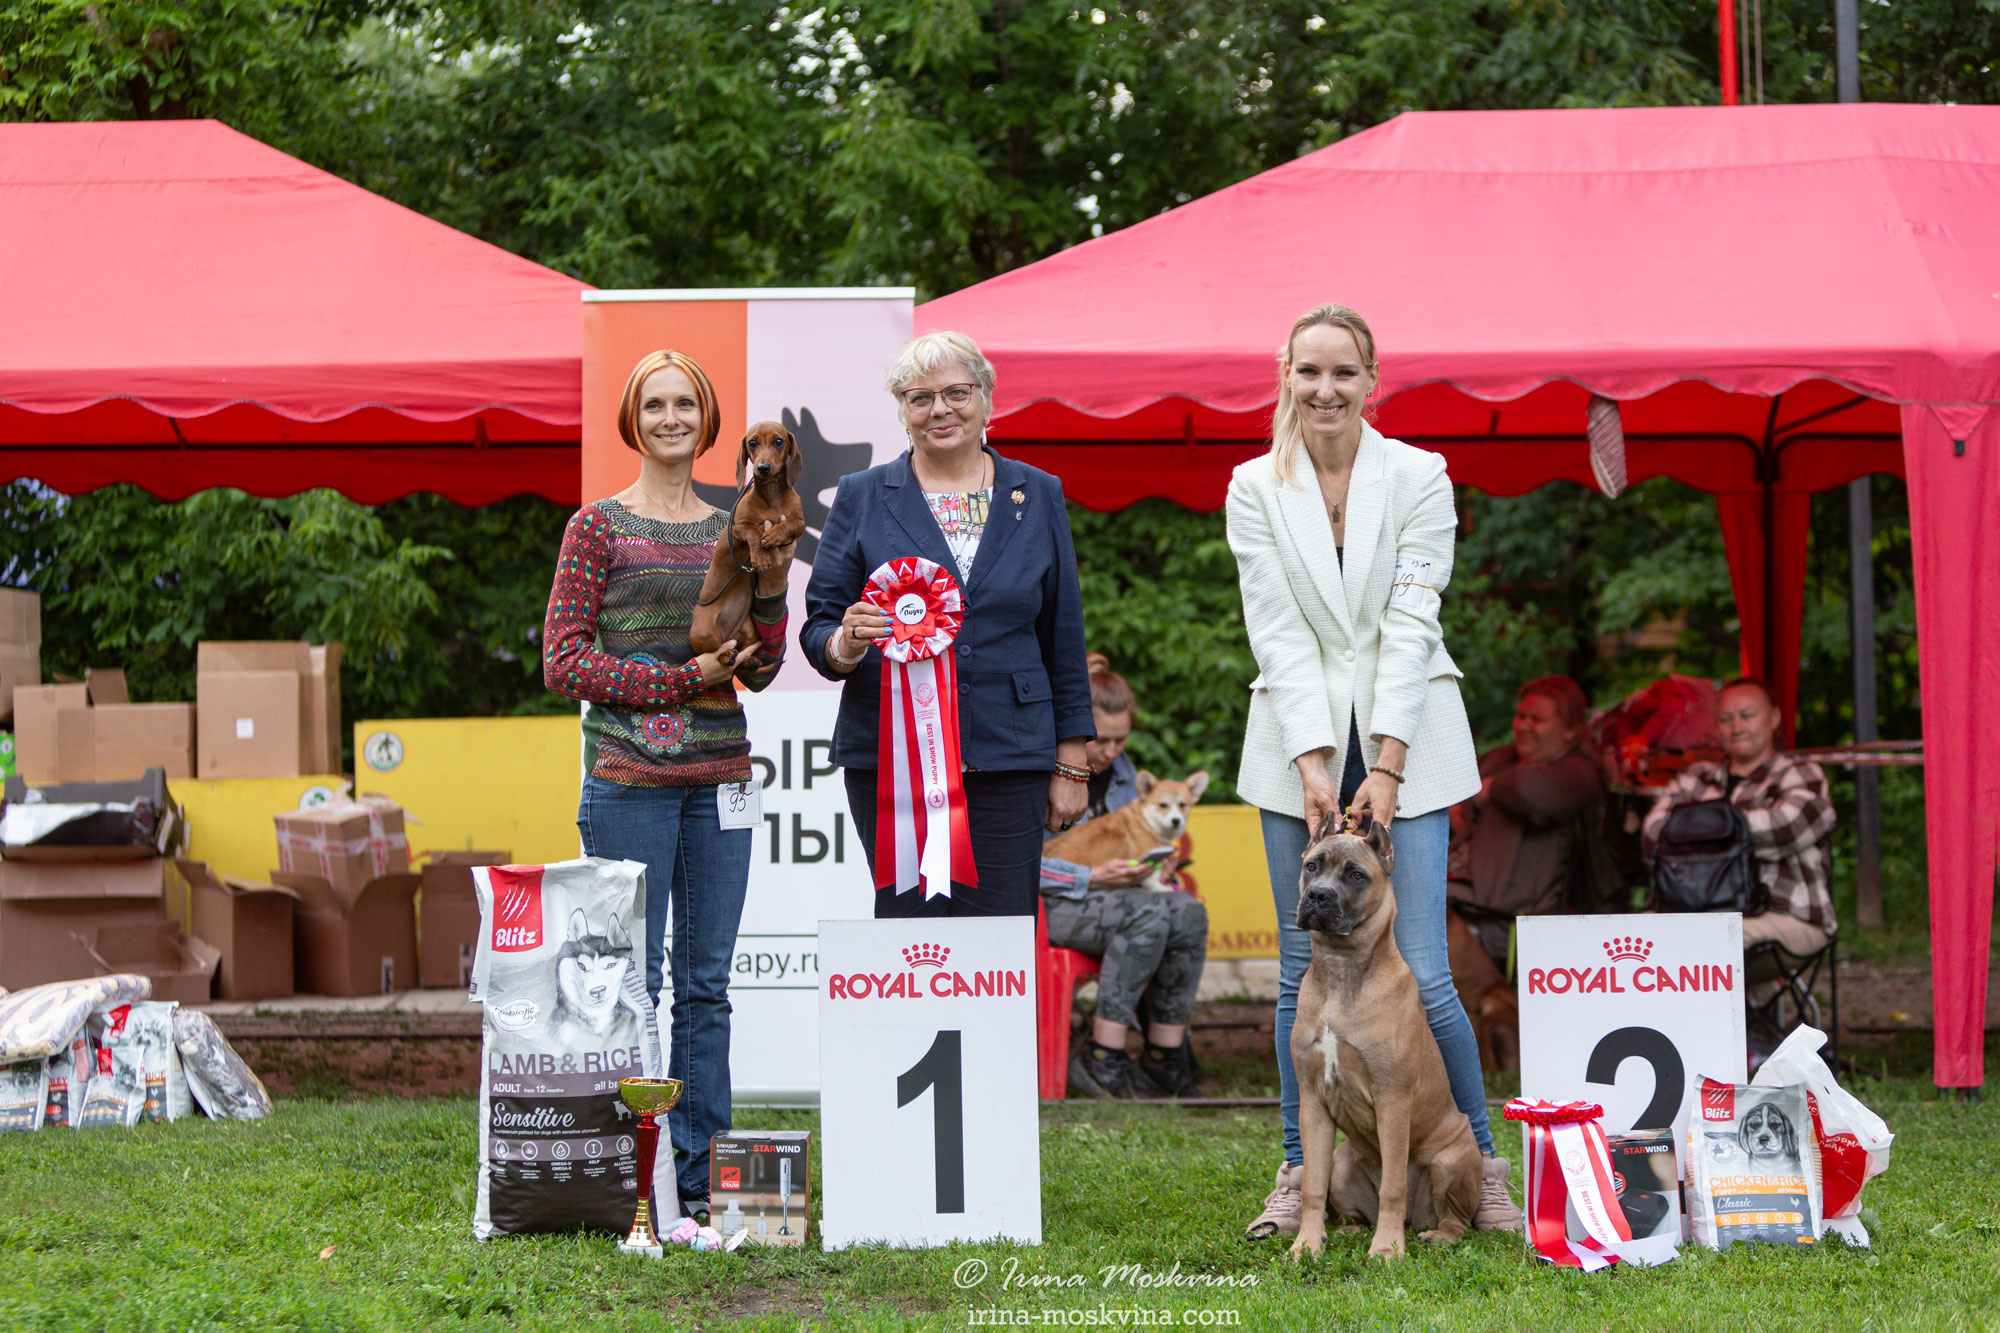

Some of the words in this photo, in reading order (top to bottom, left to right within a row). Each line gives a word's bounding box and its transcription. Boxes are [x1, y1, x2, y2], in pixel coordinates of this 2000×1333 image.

[926, 723, 934, 738] BEST
[929, 746, 937, 764] SHOW
[729, 791, 754, 813] 95
[934, 795, 941, 804] 1
[495, 926, 537, 948] Blitz
[829, 972, 923, 1000] ROYAL
[930, 970, 1026, 998] CANIN
[1528, 966, 1626, 994] ROYAL
[1632, 964, 1733, 992] CANIN
[489, 1052, 556, 1075] LAMB
[560, 1052, 580, 1075] &
[584, 1046, 642, 1073] RICE
[493, 1083, 521, 1093] ADULT
[535, 1085, 546, 1093] 12
[594, 1081, 606, 1091] all
[493, 1103, 575, 1129] Sensitive
[1704, 1107, 1731, 1119] Blitz
[897, 1029, 965, 1214] 1
[753, 1144, 801, 1153] STARWIND
[1623, 1145, 1669, 1154] STARWIND
[1581, 1190, 1592, 1205] BEST
[1717, 1197, 1754, 1209] Classic
